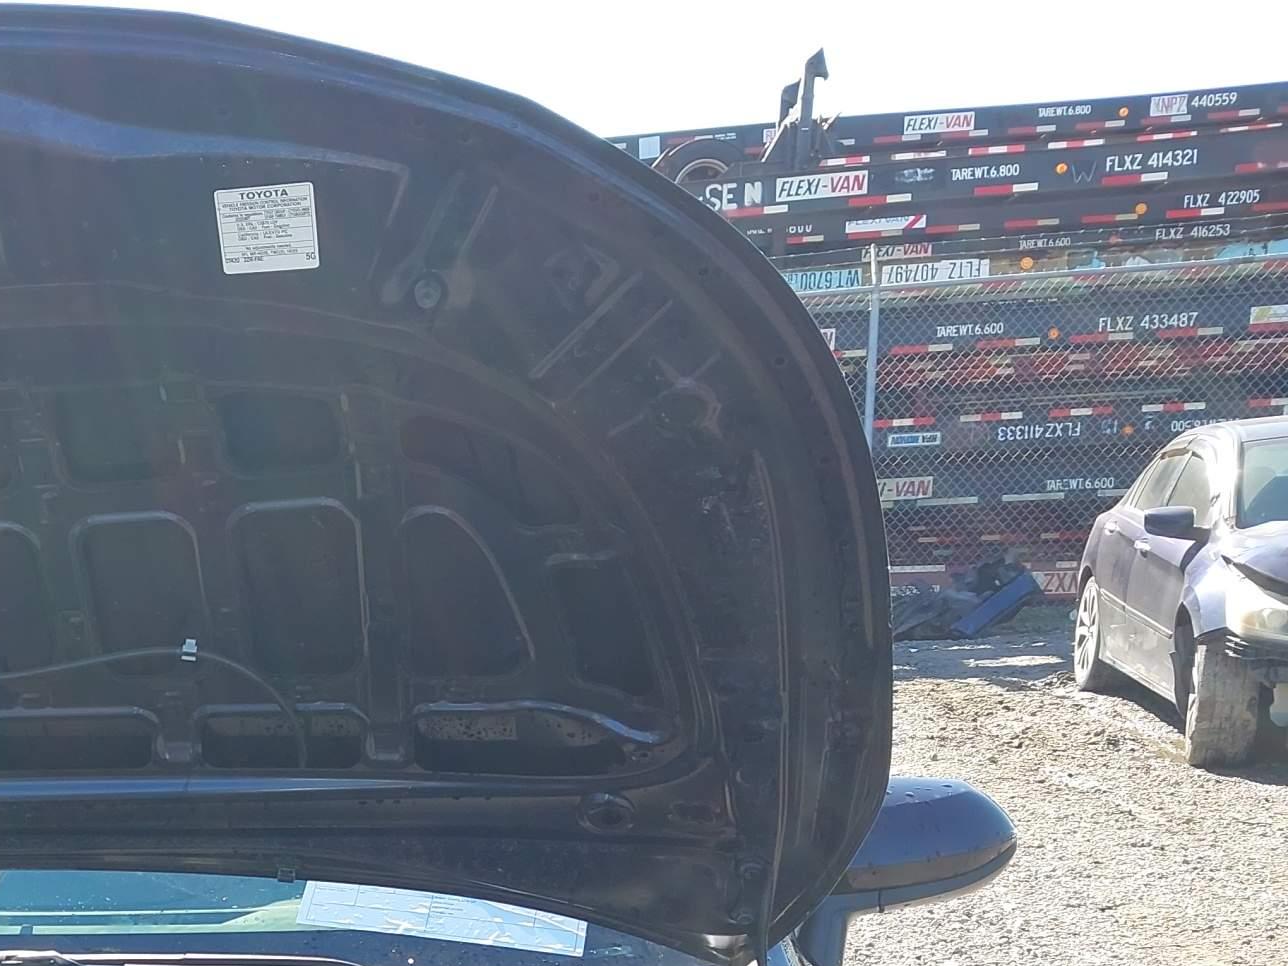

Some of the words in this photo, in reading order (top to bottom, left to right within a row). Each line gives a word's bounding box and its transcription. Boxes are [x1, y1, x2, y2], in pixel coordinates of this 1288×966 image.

[1191, 92, 1238, 108] 440559
[905, 113, 973, 132] FLEXI-VAN
[1105, 153, 1144, 172] FLXZ
[1147, 149, 1198, 168] 414321
[239, 188, 289, 200] TOYOTA
[778, 174, 866, 198] FLEXI-VAN
[1183, 193, 1211, 209] FLXZ
[1217, 189, 1261, 206] 422905
[1155, 227, 1184, 241] FLXZ
[1190, 224, 1231, 238] 416253
[886, 264, 940, 284] 407497
[948, 259, 982, 280] FLTZ
[1098, 315, 1134, 332] FLXZ
[1140, 311, 1199, 330] 433487
